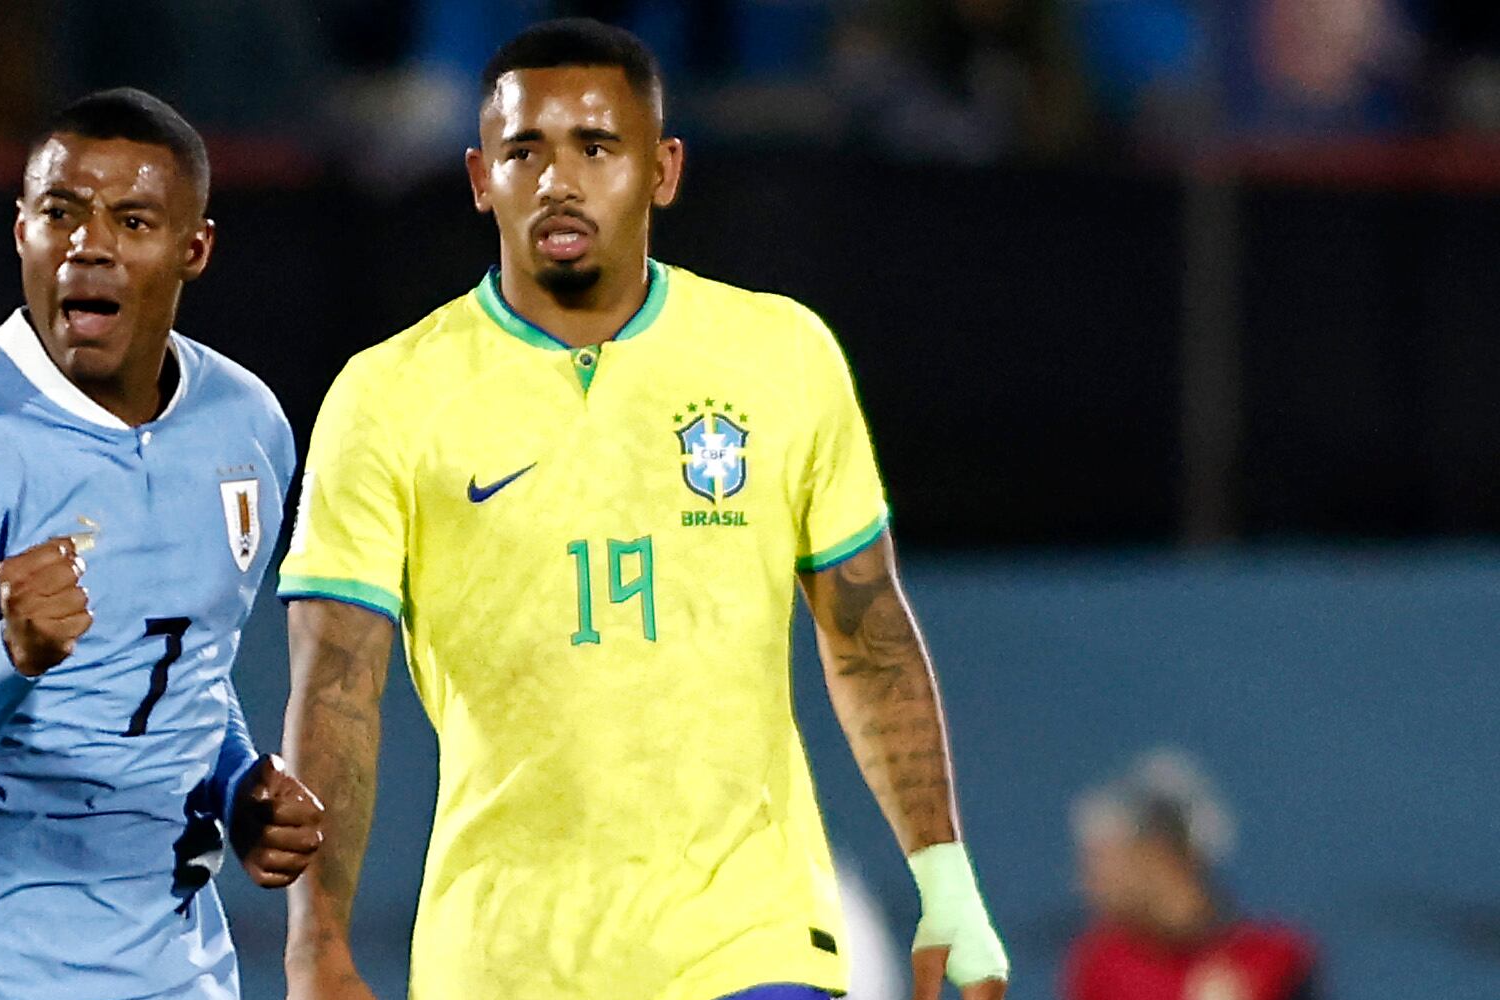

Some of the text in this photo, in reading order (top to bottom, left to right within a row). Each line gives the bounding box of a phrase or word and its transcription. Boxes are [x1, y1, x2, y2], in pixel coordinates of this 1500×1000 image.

[701, 449, 727, 460] CBF
[681, 510, 749, 527] BRASIL
[566, 533, 657, 647] 19
[120, 616, 192, 738] 7
